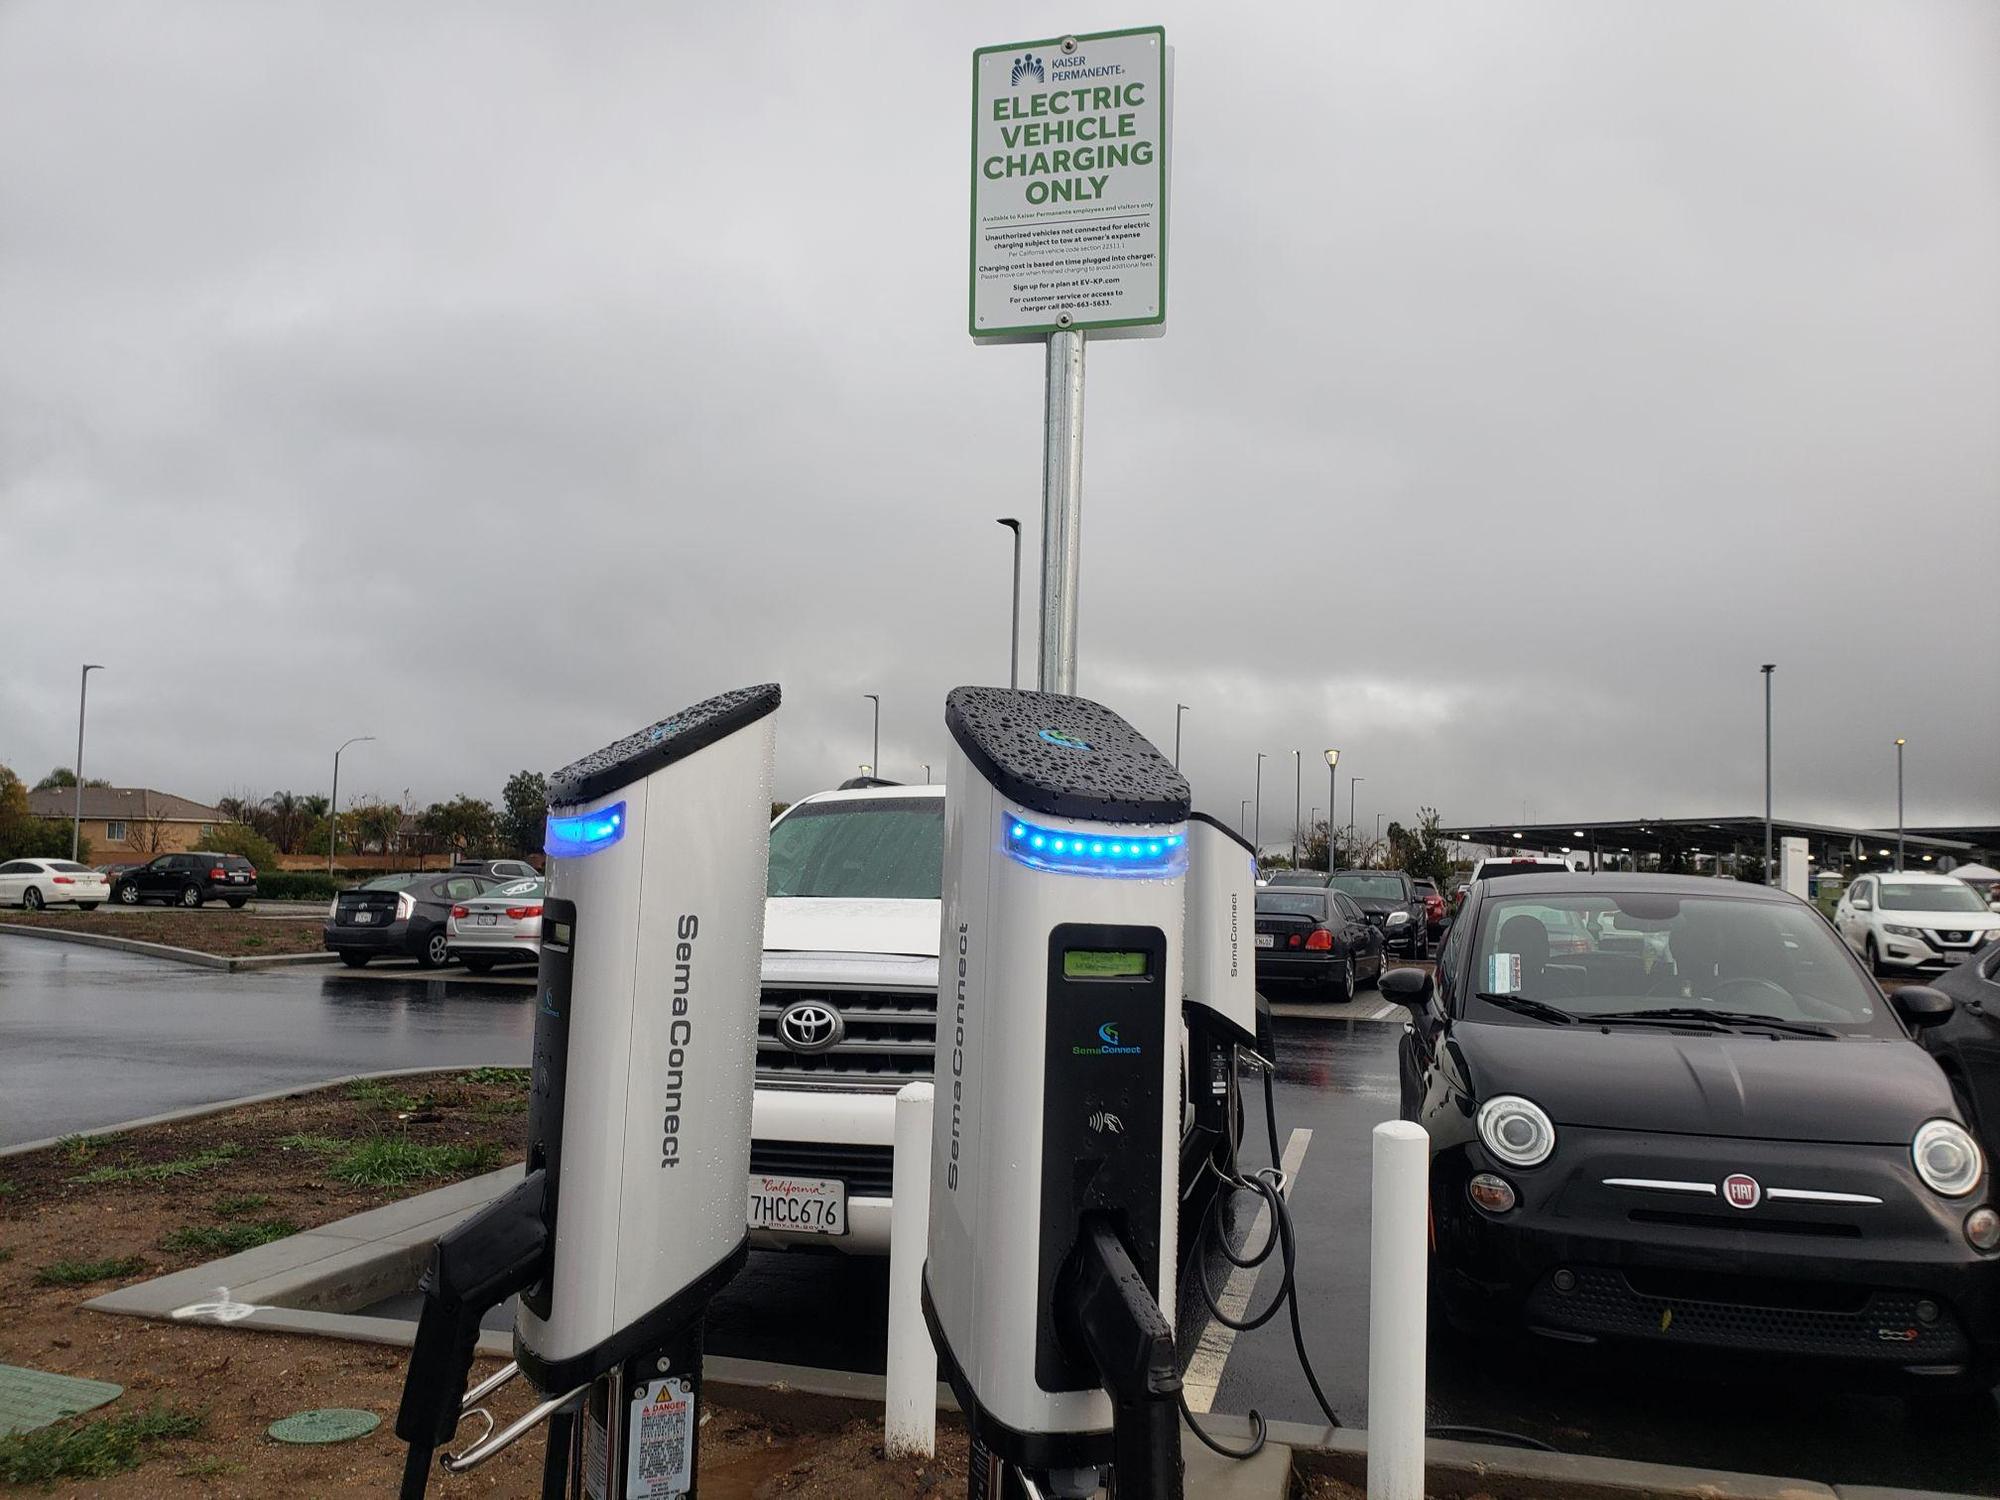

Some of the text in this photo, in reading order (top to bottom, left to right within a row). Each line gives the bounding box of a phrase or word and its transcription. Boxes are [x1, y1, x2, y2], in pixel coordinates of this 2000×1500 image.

[1052, 56, 1086, 68] KAISER
[993, 82, 1145, 121] ELECTRIC
[1000, 112, 1136, 149] VEHICLE
[983, 141, 1152, 180] CHARGING
[1025, 174, 1109, 204] ONLY
[985, 231, 1031, 241] Unauthorized
[1032, 229, 1060, 237] vehicles
[1075, 225, 1111, 234] connected
[1111, 232, 1140, 240] expense
[1082, 256, 1110, 264] plugged
[662, 914, 698, 1169] SemaConnect
[948, 922, 968, 1192] SemaConnect
[1072, 1046, 1141, 1056] SemaConnect
[765, 1180, 825, 1196] California
[1731, 1184, 1752, 1200] FIAT
[751, 1196, 836, 1225] 7HCC676
[652, 1401, 686, 1412] DANGER
